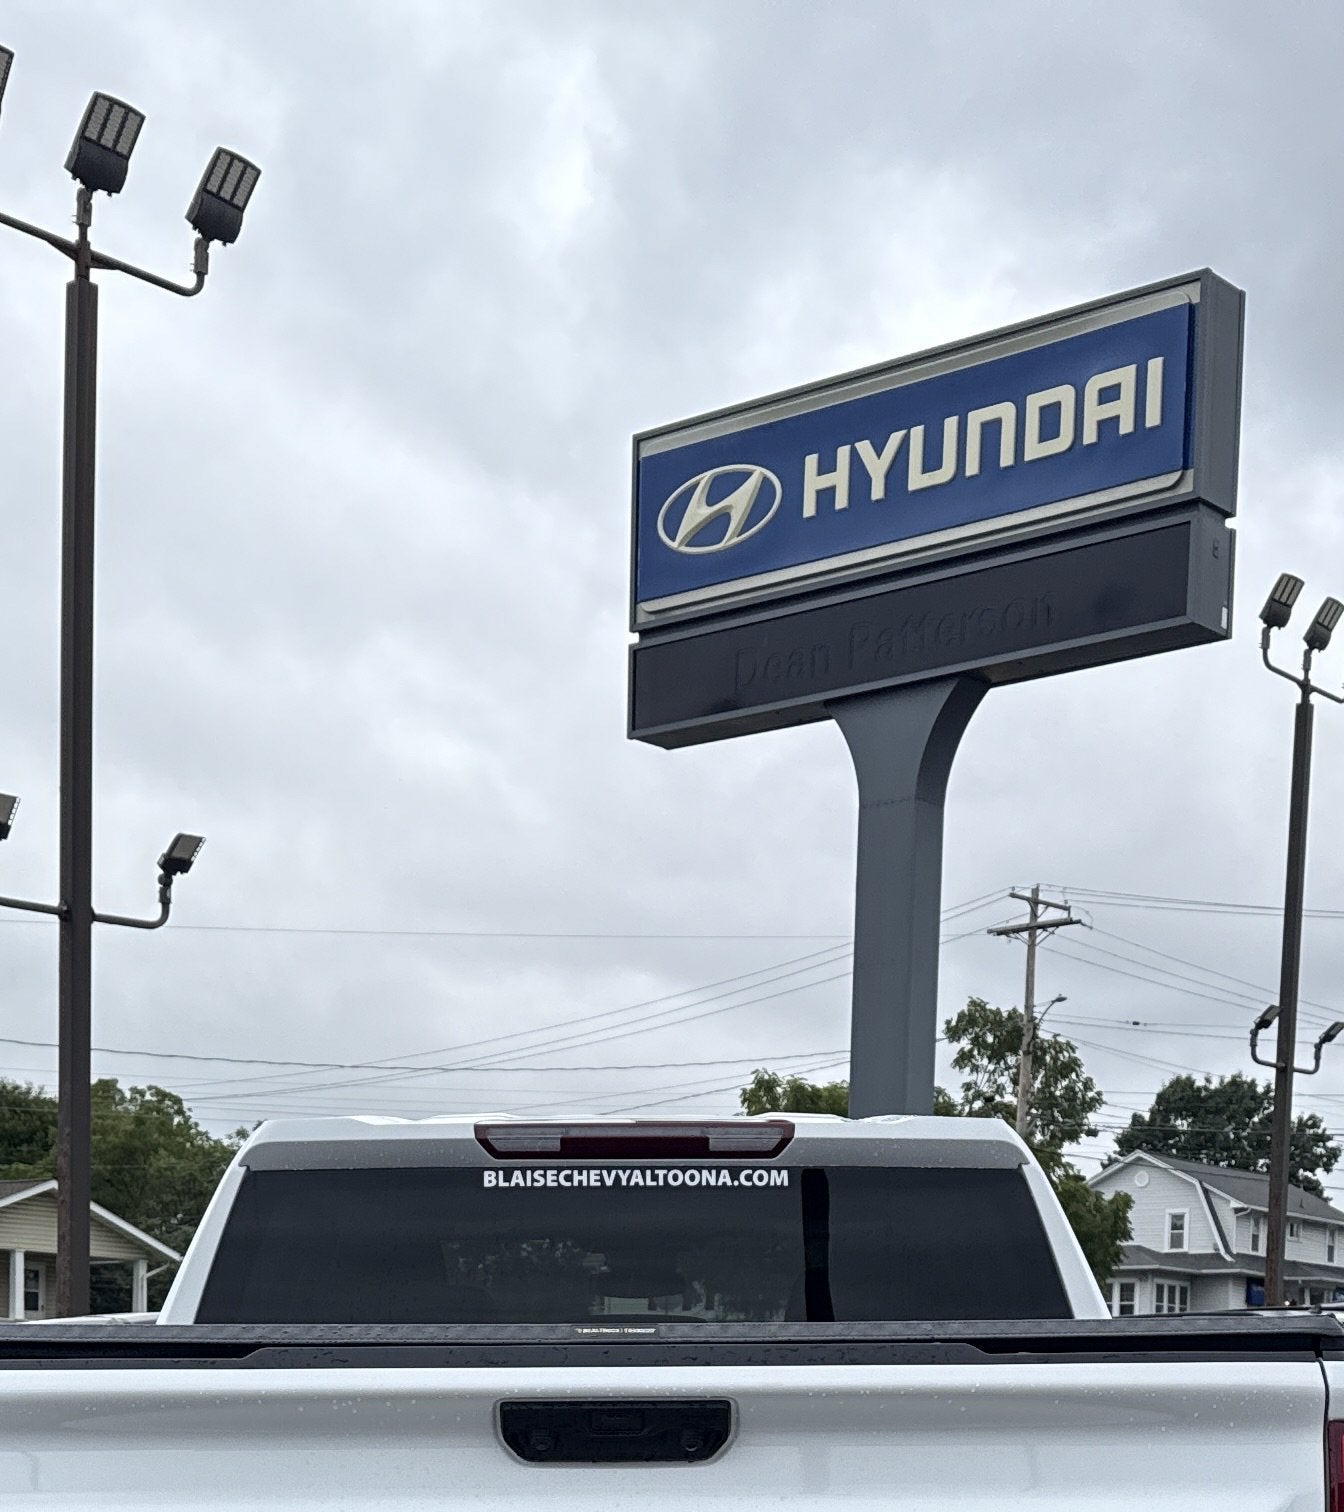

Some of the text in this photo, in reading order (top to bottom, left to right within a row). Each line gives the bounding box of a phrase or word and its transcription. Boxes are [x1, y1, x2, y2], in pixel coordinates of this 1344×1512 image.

[803, 356, 1164, 519] HYUNDAI
[733, 590, 1056, 691] Dean Patterson
[483, 1169, 789, 1187] BLAISECHEVYALTOONA.COM
